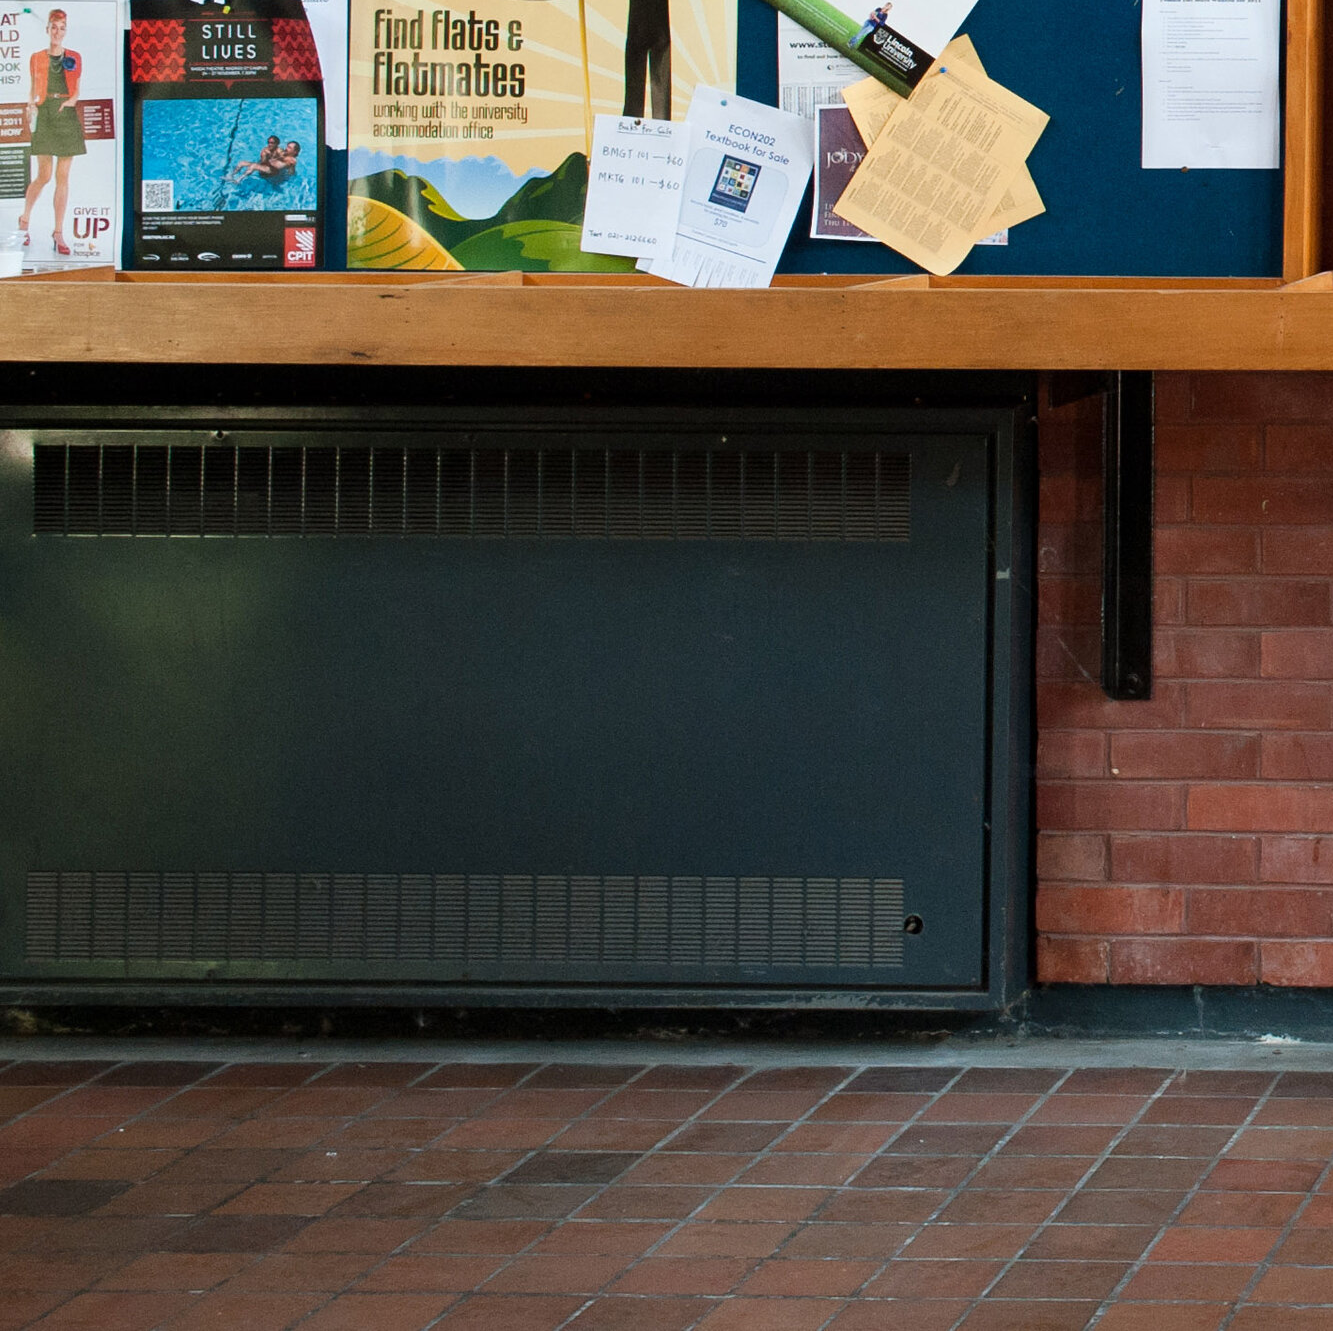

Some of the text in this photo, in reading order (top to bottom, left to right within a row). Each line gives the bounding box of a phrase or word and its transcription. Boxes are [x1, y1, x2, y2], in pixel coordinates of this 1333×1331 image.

[201, 24, 257, 39] STILL
[374, 9, 524, 52] find flats &
[201, 44, 257, 60] LIVES
[373, 51, 525, 98] flatmates
[373, 101, 528, 124] working with the university
[373, 121, 494, 139] accommodation office
[728, 124, 776, 147] ECON202
[602, 146, 633, 159] BMGT
[637, 148, 649, 160] 101
[705, 130, 790, 166] Textbook for Sale
[73, 217, 110, 239] UP
[287, 251, 313, 261] CPIT
